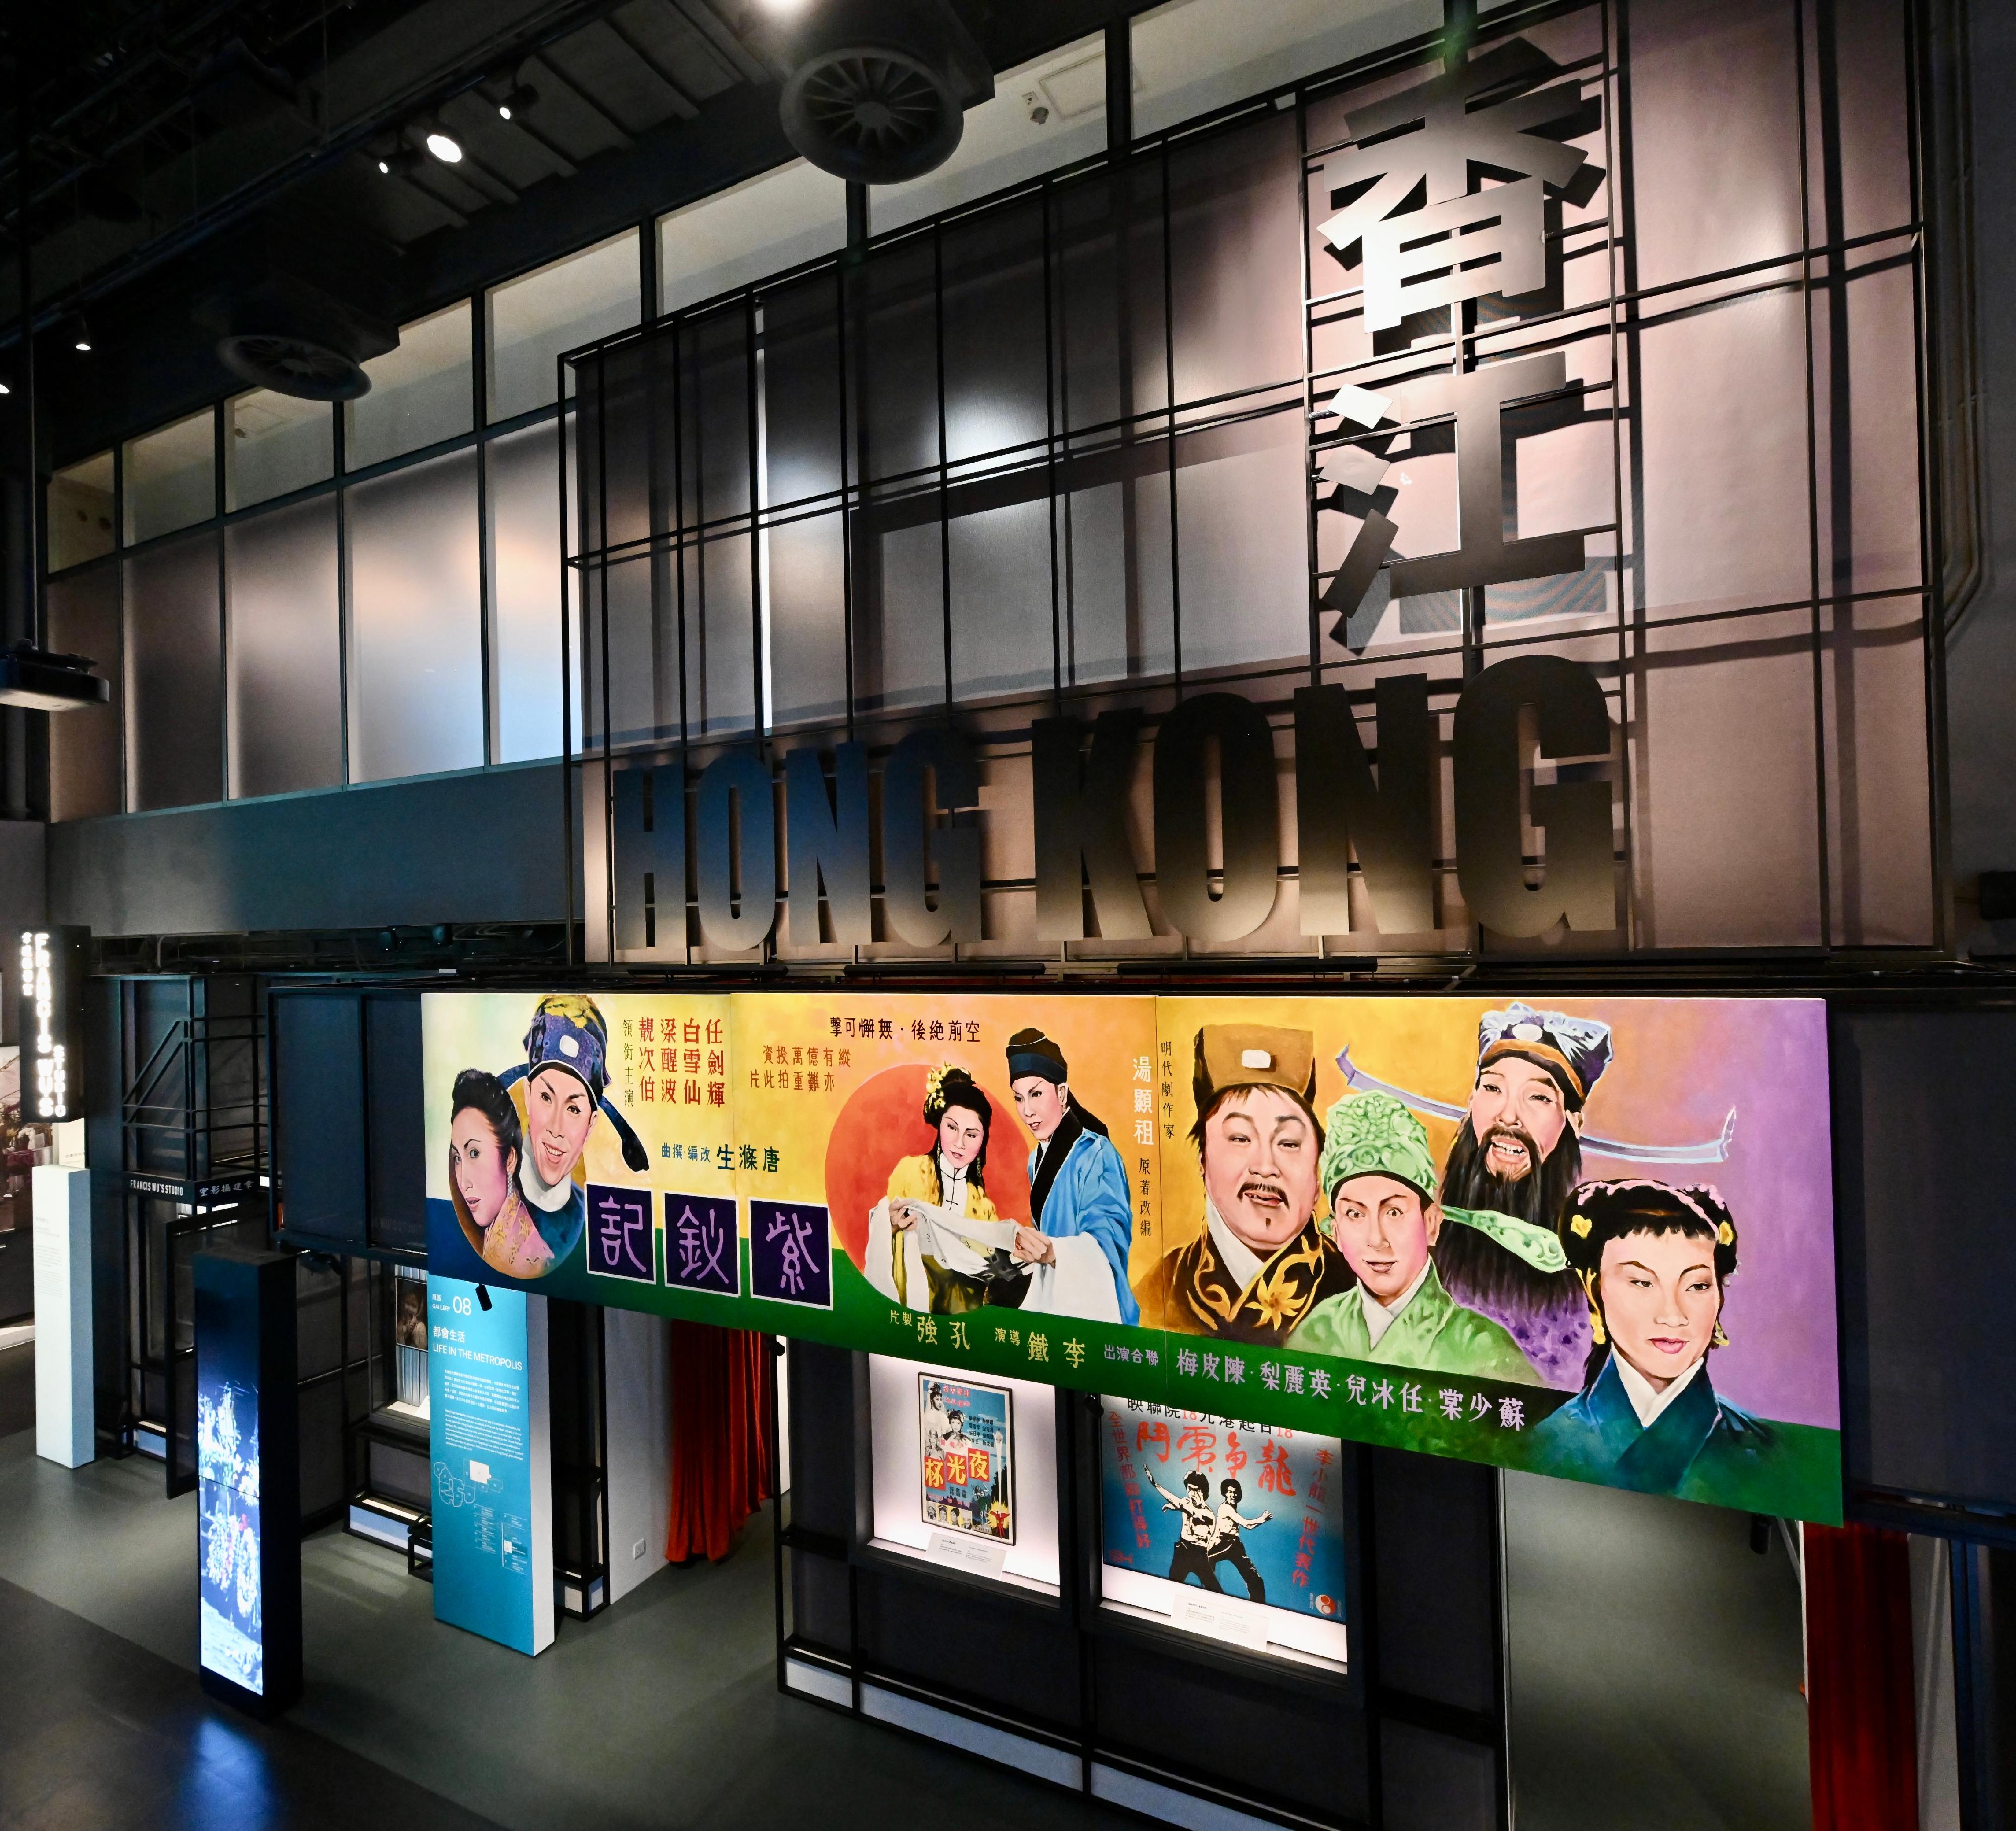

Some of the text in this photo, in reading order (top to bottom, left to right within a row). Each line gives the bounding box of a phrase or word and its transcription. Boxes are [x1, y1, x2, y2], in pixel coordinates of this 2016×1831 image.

[1316, 36, 1589, 619] 香江
[613, 654, 1616, 951] HONG KONG
[638, 1016, 656, 1102] 靚次伯
[660, 1018, 678, 1104] 梁醒波
[683, 1017, 701, 1106] 白雪仙
[705, 1018, 725, 1108] 任劍輝
[1161, 1041, 1175, 1139] 明代劇作家
[130, 1179, 151, 1191] FRANCIS
[165, 1185, 184, 1196] STUDIO
[1132, 1056, 1154, 1237] 湯顯祖 原著改編
[432, 1296, 471, 1316] GALLERY 08
[433, 1326, 465, 1344] 都會生活
[995, 1327, 1085, 1369] 李鐵 導演
[433, 1343, 523, 1371] LIFE IN THE METROPOLIS
[925, 1451, 988, 1488] 夜光杯
